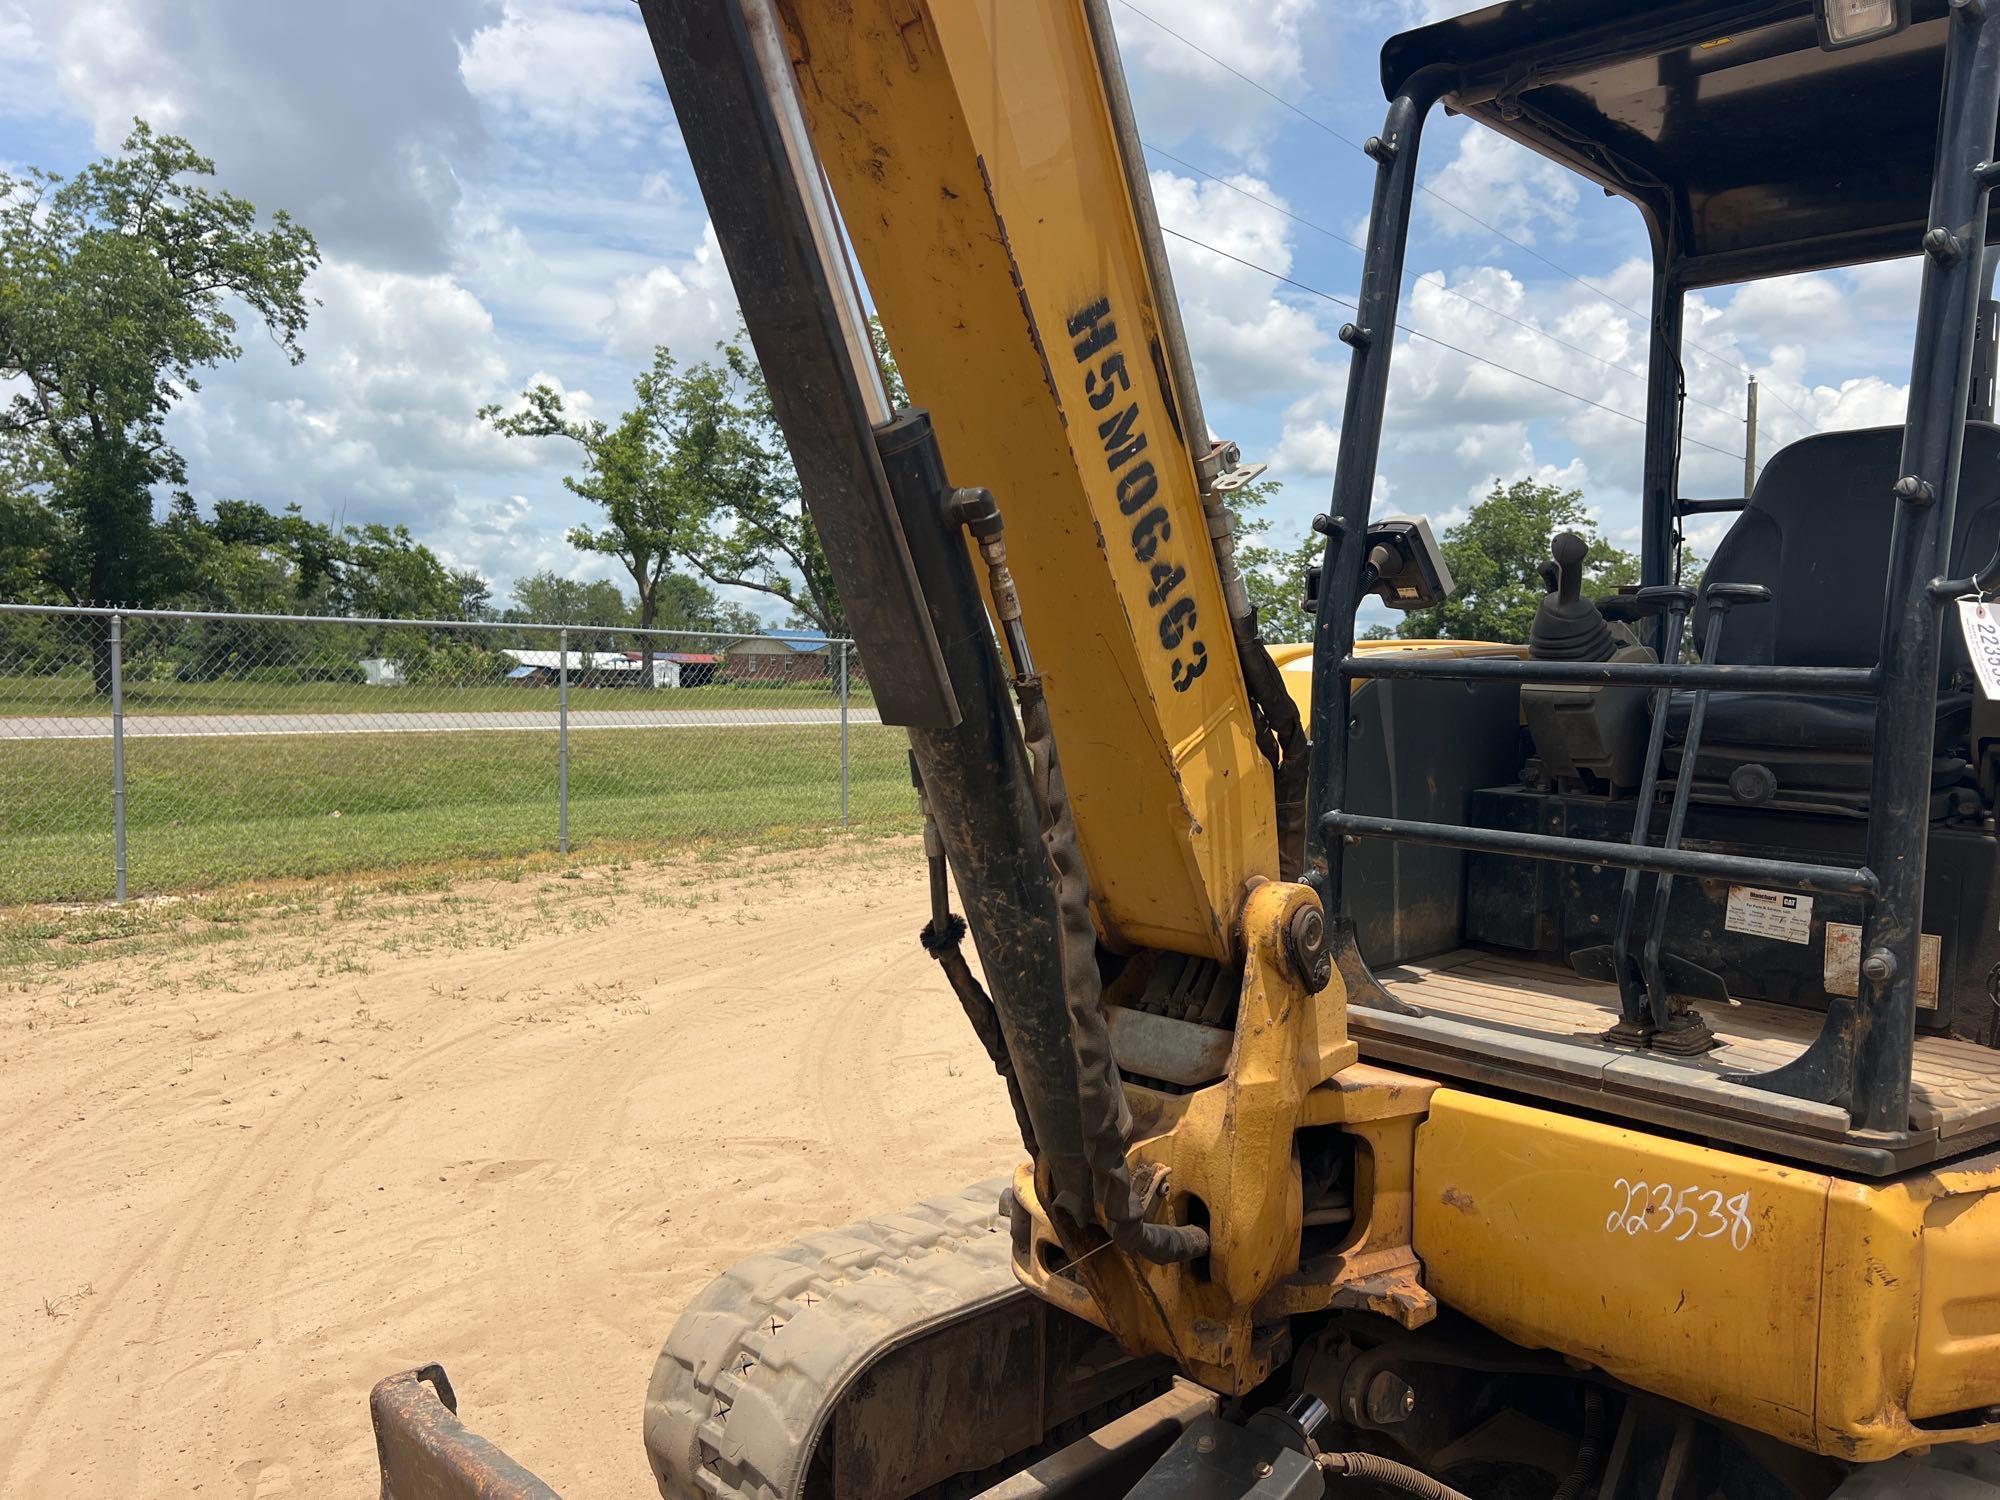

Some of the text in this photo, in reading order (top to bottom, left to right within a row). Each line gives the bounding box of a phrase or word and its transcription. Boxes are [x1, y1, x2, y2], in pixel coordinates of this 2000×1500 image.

[1066, 296, 1209, 693] H5M06463
[1783, 898, 1796, 907] CAT
[1606, 1178, 1752, 1251] 223538
